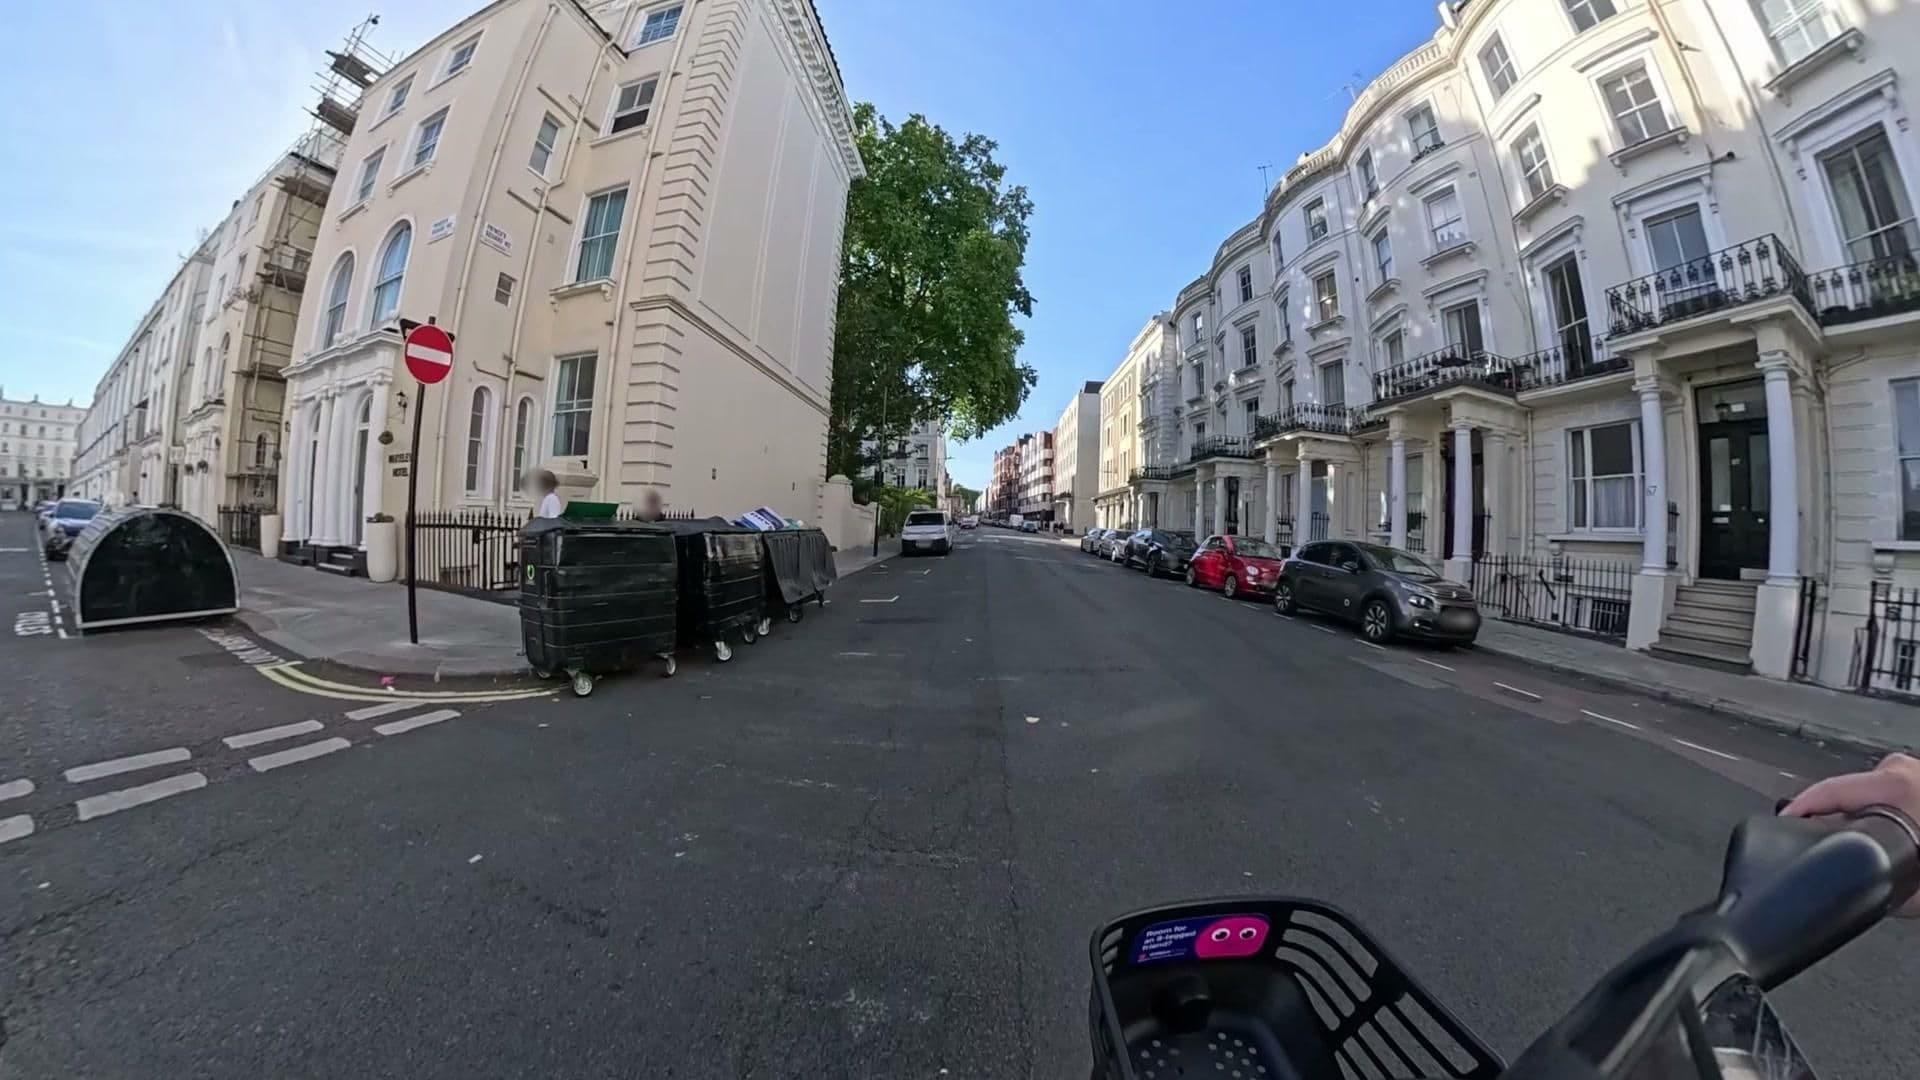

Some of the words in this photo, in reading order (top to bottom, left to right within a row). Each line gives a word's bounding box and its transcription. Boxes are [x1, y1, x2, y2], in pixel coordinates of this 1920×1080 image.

[1146, 928, 1172, 937] Room
[1156, 930, 1196, 941] 8-legged
[1142, 940, 1172, 951] friend?
